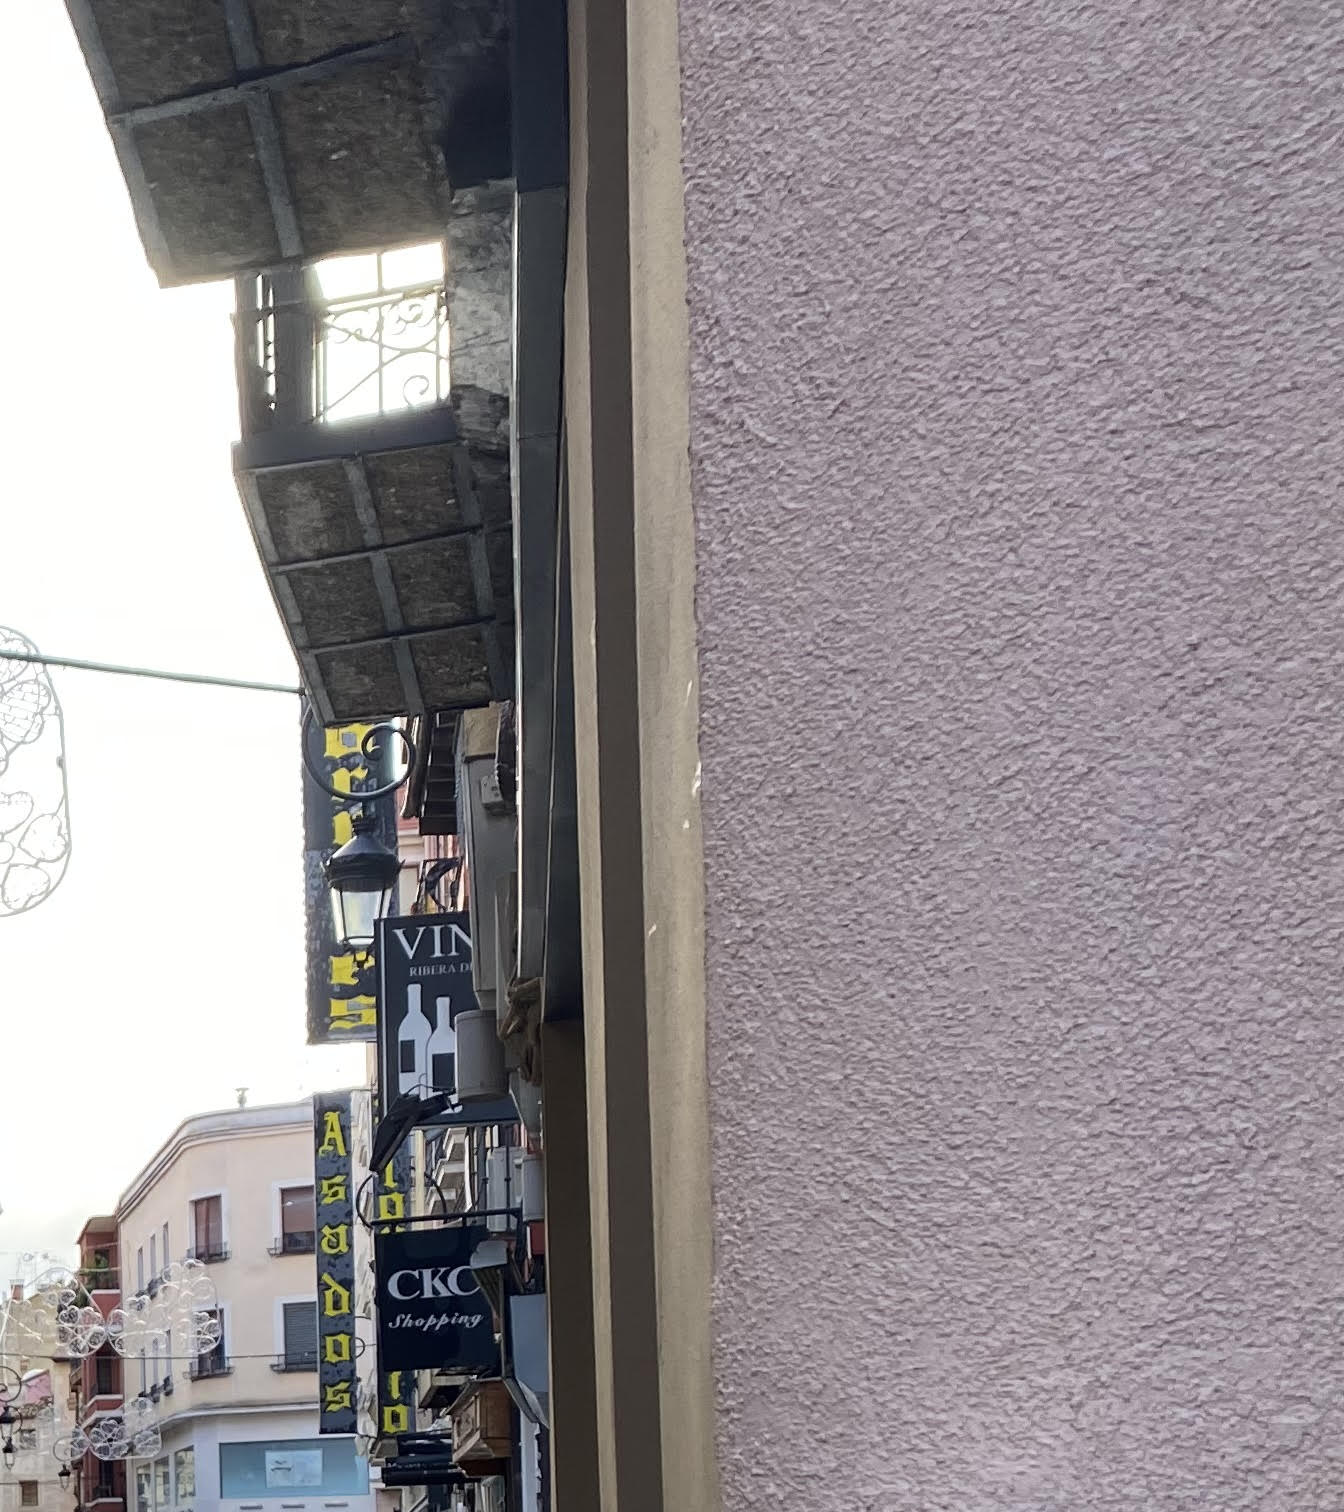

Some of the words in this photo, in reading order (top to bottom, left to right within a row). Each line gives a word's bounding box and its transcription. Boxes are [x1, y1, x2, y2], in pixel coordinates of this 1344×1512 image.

[409, 963, 456, 977] RIBERA
[460, 961, 472, 972] D
[318, 1110, 354, 1413] Asados
[387, 1265, 482, 1300] CKC
[388, 1311, 484, 1332] Shopping
